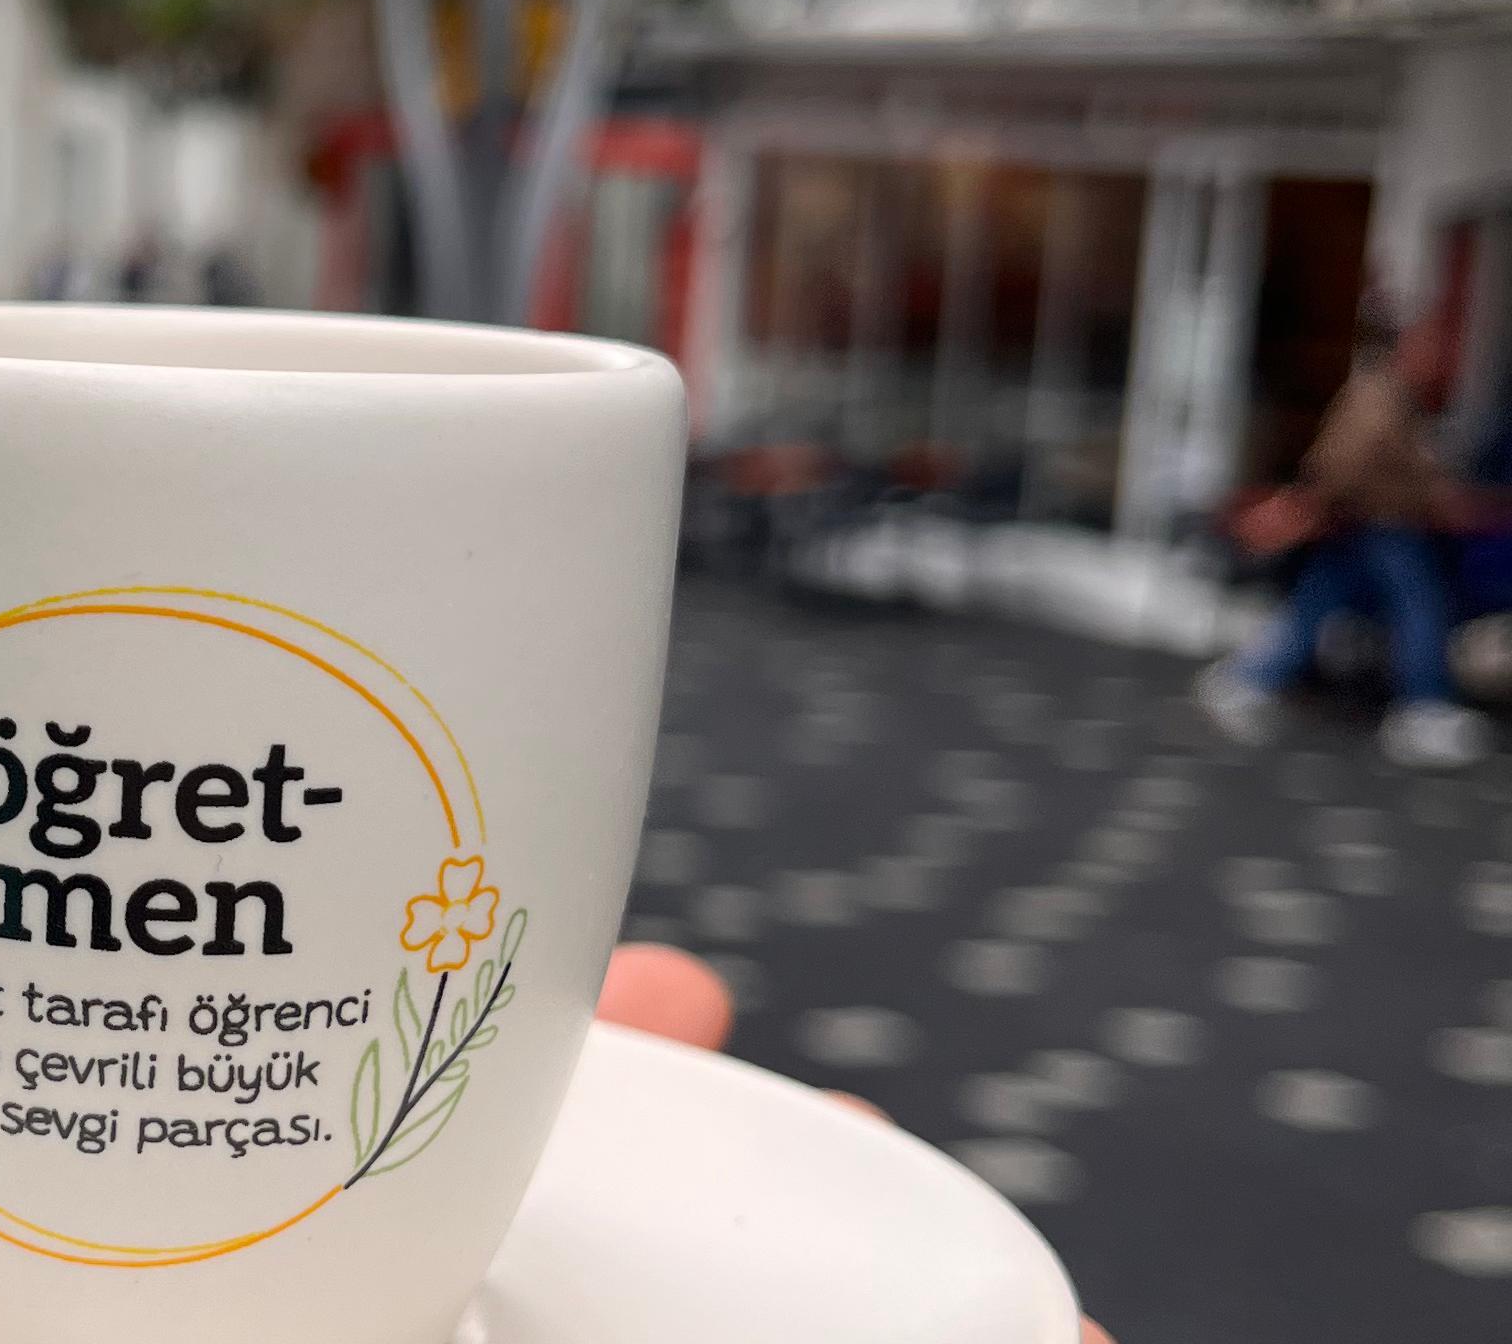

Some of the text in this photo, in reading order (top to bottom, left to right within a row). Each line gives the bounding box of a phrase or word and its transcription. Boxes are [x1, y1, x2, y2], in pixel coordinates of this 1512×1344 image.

[22, 983, 167, 1031] tarafı
[189, 989, 371, 1047] öğrenci
[16, 1049, 156, 1090] çevrili
[178, 1051, 320, 1104] büyük
[137, 1115, 331, 1158] parçası.
